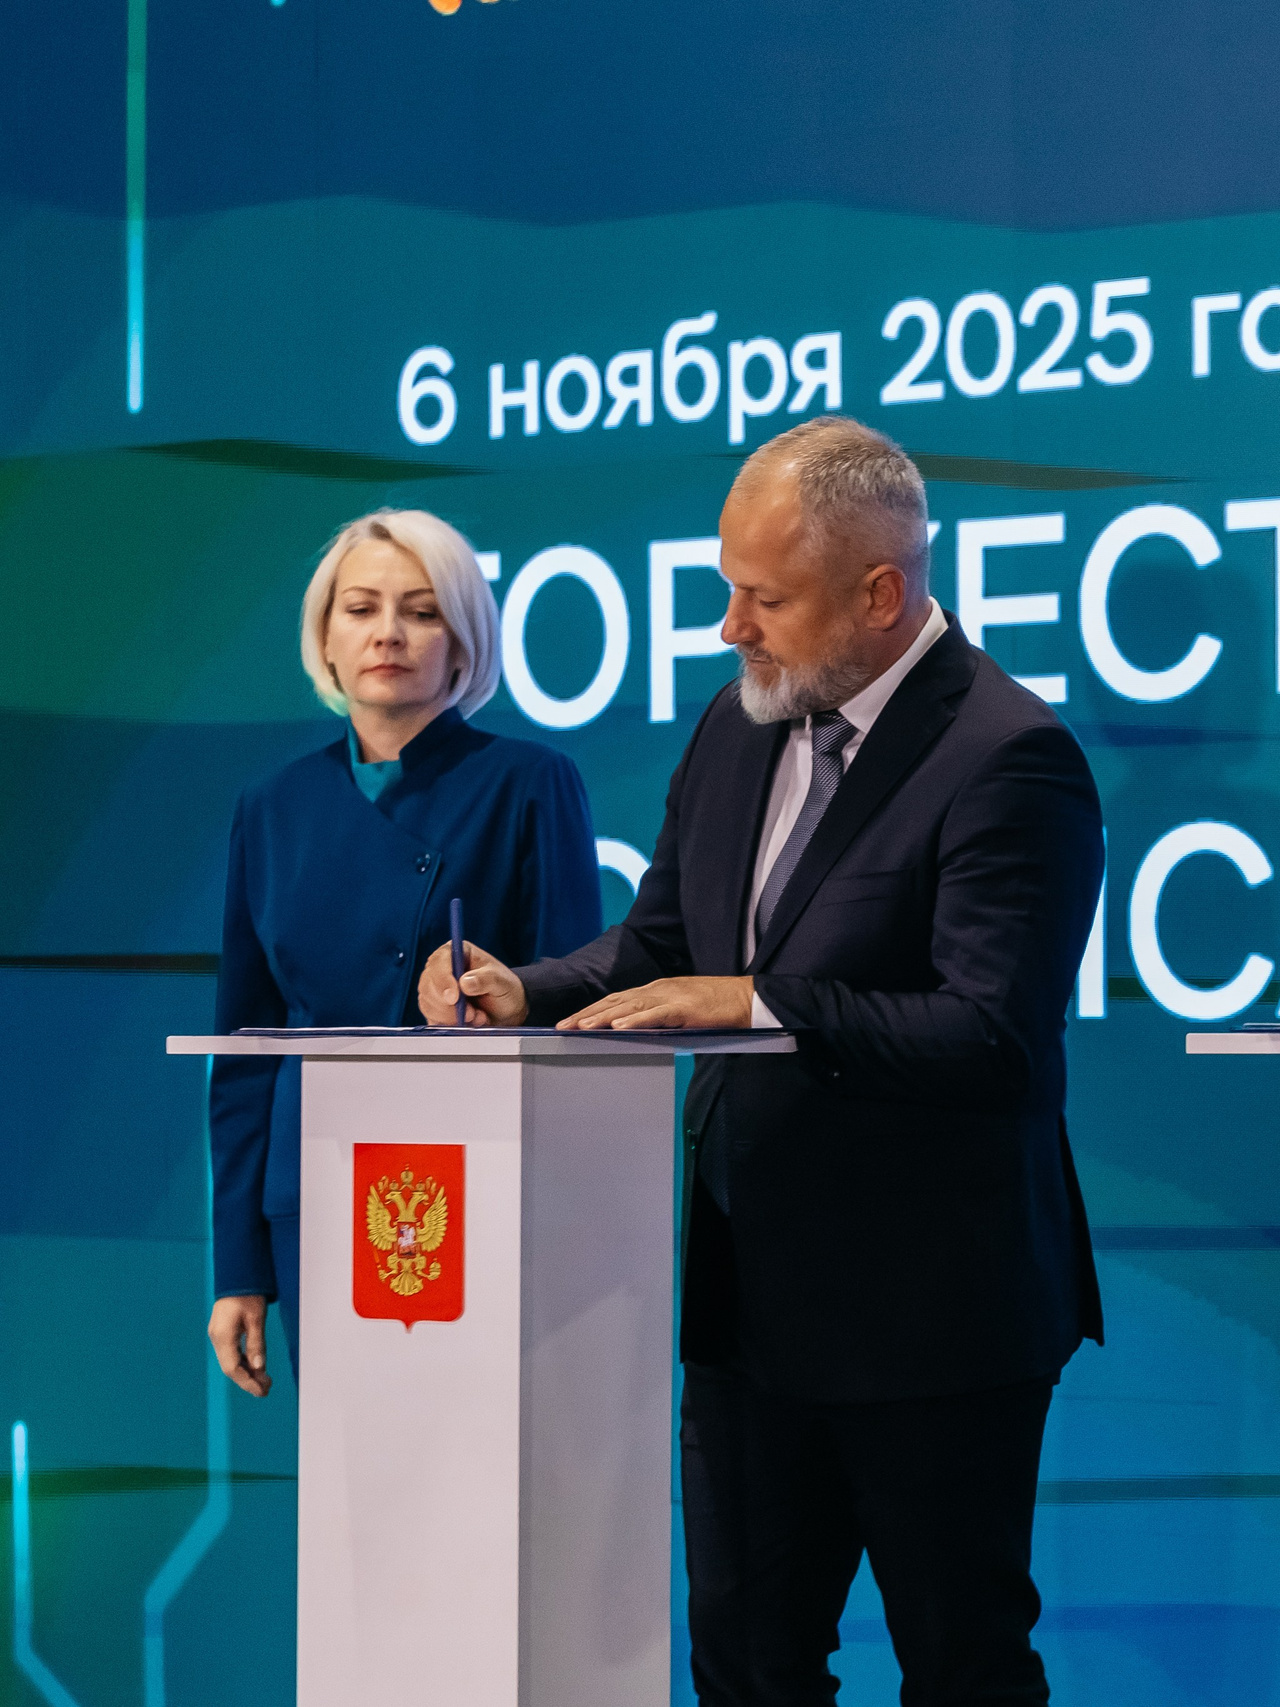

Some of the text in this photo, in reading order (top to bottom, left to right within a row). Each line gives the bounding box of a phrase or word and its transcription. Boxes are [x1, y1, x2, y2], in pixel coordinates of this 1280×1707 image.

[398, 346, 457, 445] 6
[489, 312, 842, 444] ноября
[880, 276, 1153, 404] 2025
